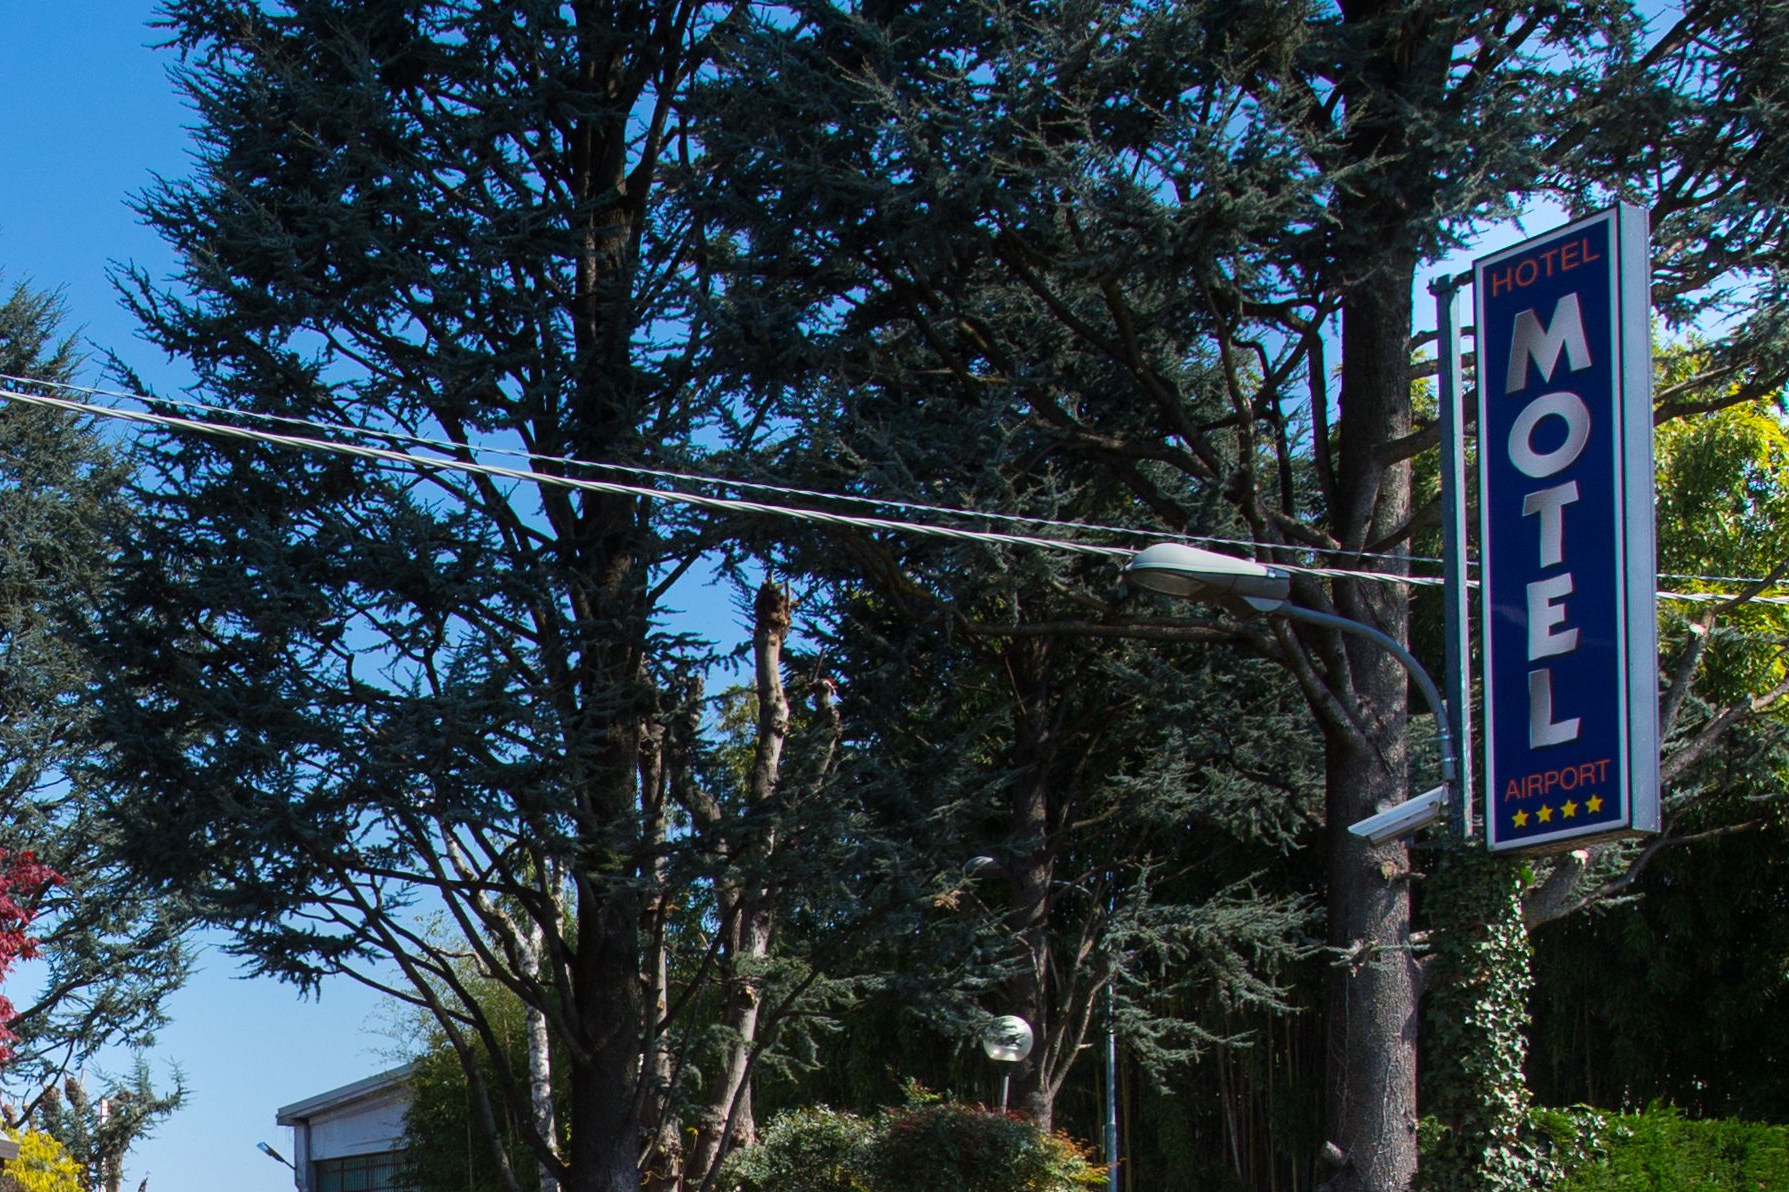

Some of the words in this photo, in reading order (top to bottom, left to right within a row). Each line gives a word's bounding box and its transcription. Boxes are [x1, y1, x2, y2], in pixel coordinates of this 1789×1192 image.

[1492, 237, 1600, 297] HOTEL
[1505, 292, 1592, 750] MOTEL
[1504, 759, 1610, 802] AIRPORT
